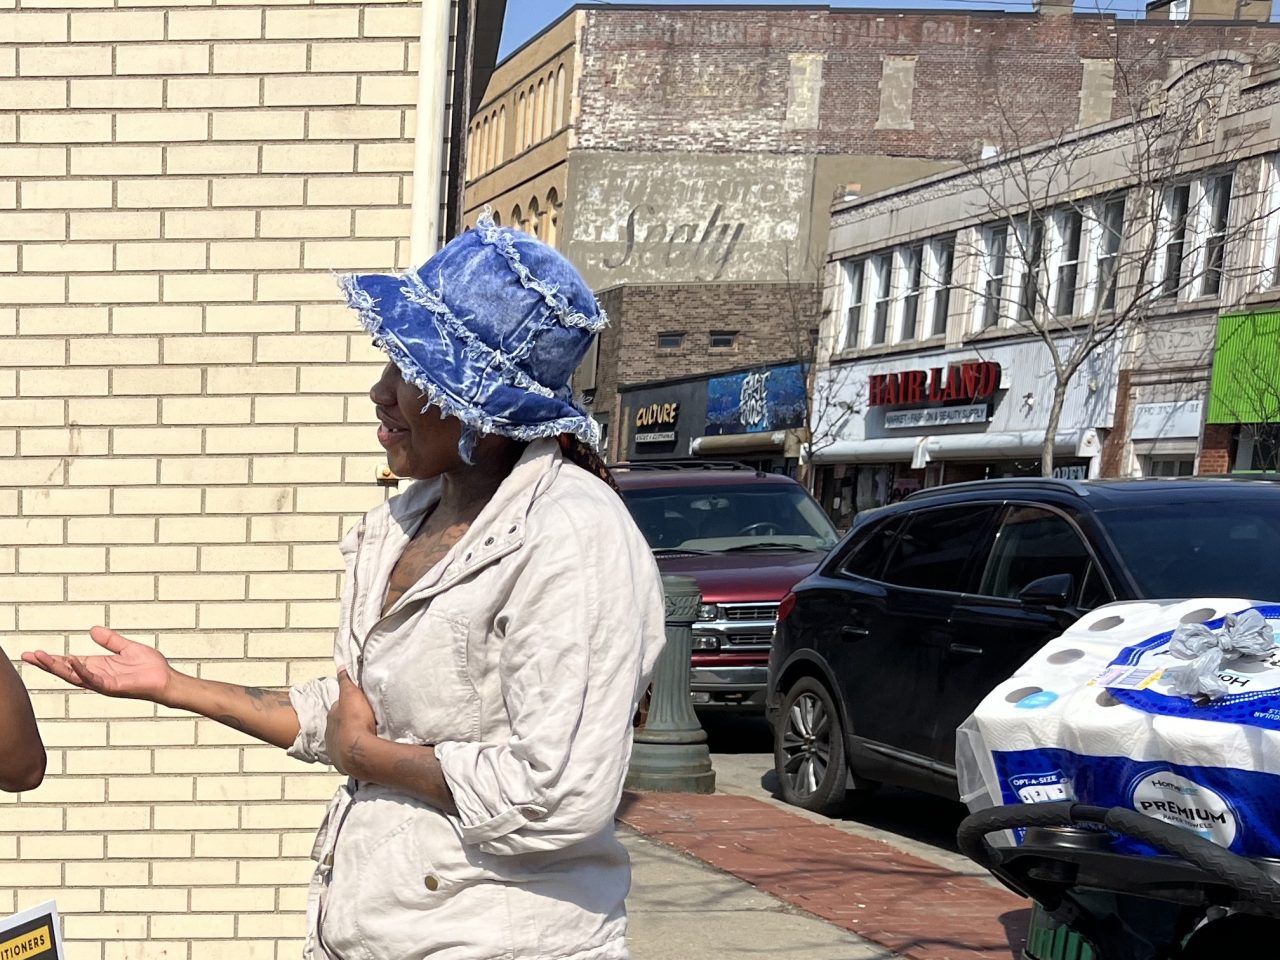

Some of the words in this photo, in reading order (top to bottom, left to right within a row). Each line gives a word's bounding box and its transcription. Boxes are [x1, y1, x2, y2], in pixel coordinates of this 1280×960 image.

[603, 203, 745, 281] Sealy
[868, 370, 925, 407] HAIR
[928, 361, 999, 402] LAND
[636, 402, 677, 427] CULTURE
[1052, 465, 1087, 480] OPEN
[1013, 775, 1058, 786] OPT-A-SIZE
[1140, 801, 1227, 824] PREMIUM
